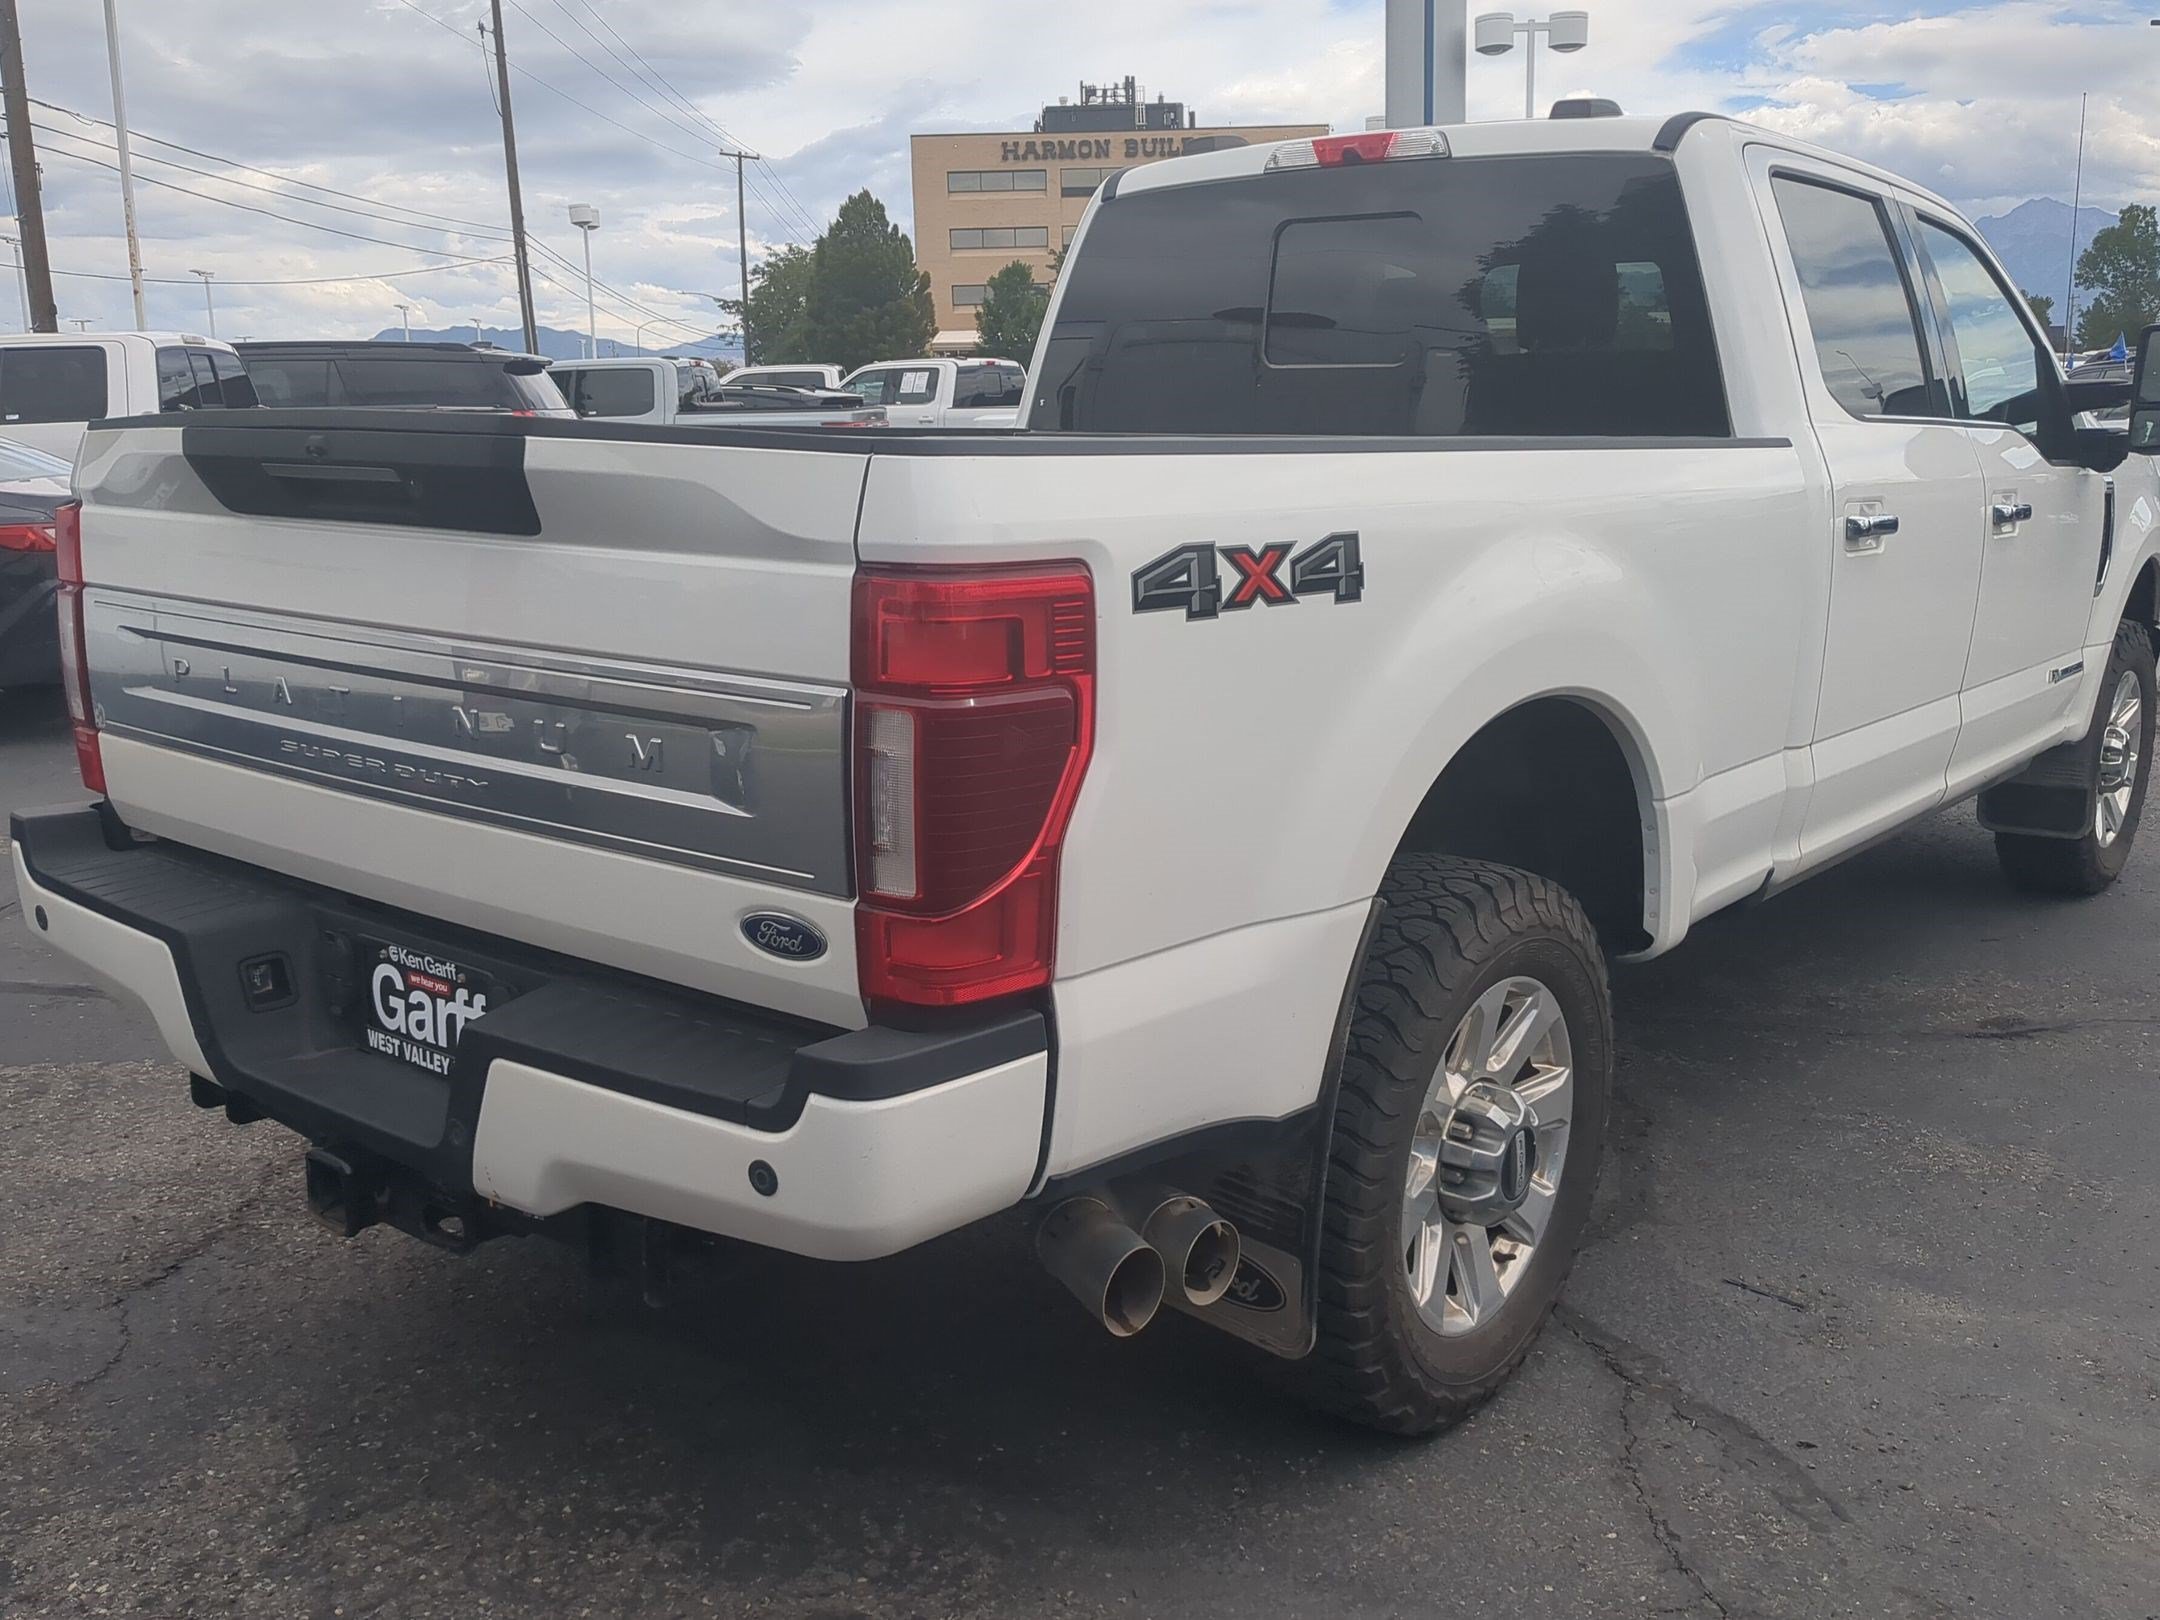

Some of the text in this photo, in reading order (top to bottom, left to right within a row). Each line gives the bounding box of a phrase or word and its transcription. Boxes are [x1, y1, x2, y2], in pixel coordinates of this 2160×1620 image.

[1001, 138, 1111, 161] HARMON
[172, 657, 664, 773] PLATINUM
[280, 739, 489, 789] SUPER DUTY
[757, 920, 802, 952] Ford
[398, 946, 457, 981] Ken Garff
[410, 974, 448, 992] we hear you
[367, 1028, 450, 1075] WEST VALLEY
